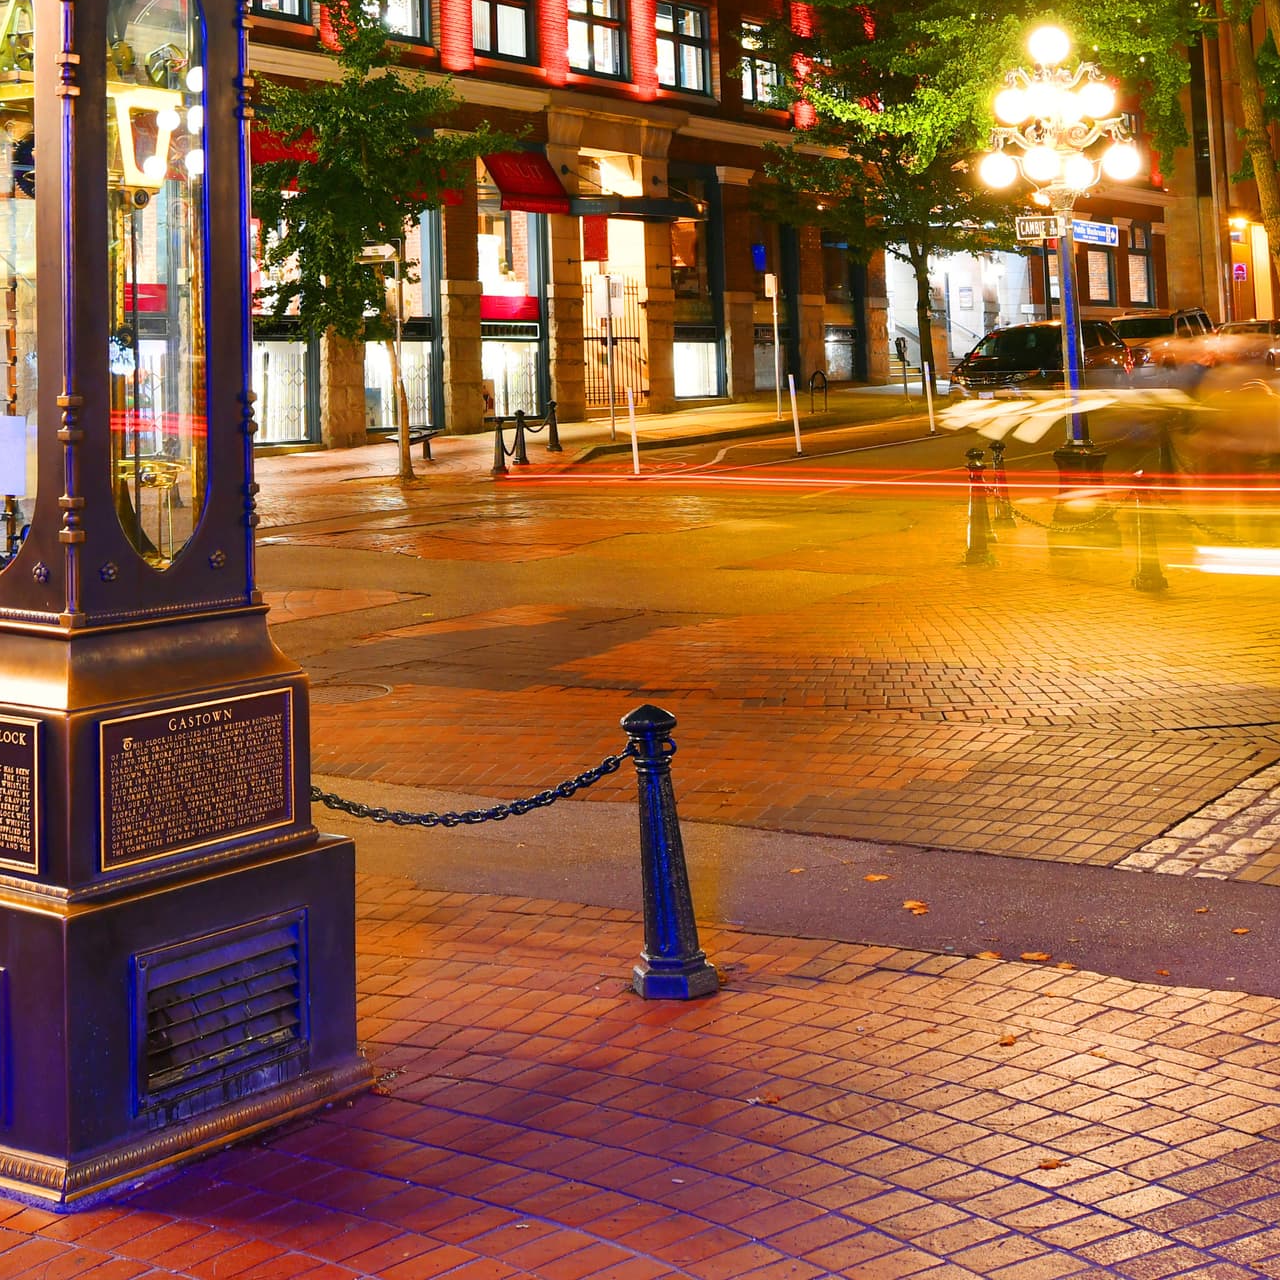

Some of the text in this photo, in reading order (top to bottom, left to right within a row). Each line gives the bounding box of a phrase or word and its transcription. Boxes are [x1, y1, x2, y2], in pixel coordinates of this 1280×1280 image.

[1020, 221, 1047, 236] CAMBIE
[169, 709, 232, 731] GASTOWN
[145, 737, 166, 746] CLOCK
[4, 773, 15, 781] THE
[16, 775, 30, 784] LIVE
[0, 788, 20, 797] TRAVEL
[22, 806, 30, 814] BY
[16, 812, 30, 821] WILL
[5, 818, 30, 829] WHISTLE
[6, 841, 18, 850] AND
[20, 844, 30, 852] THE
